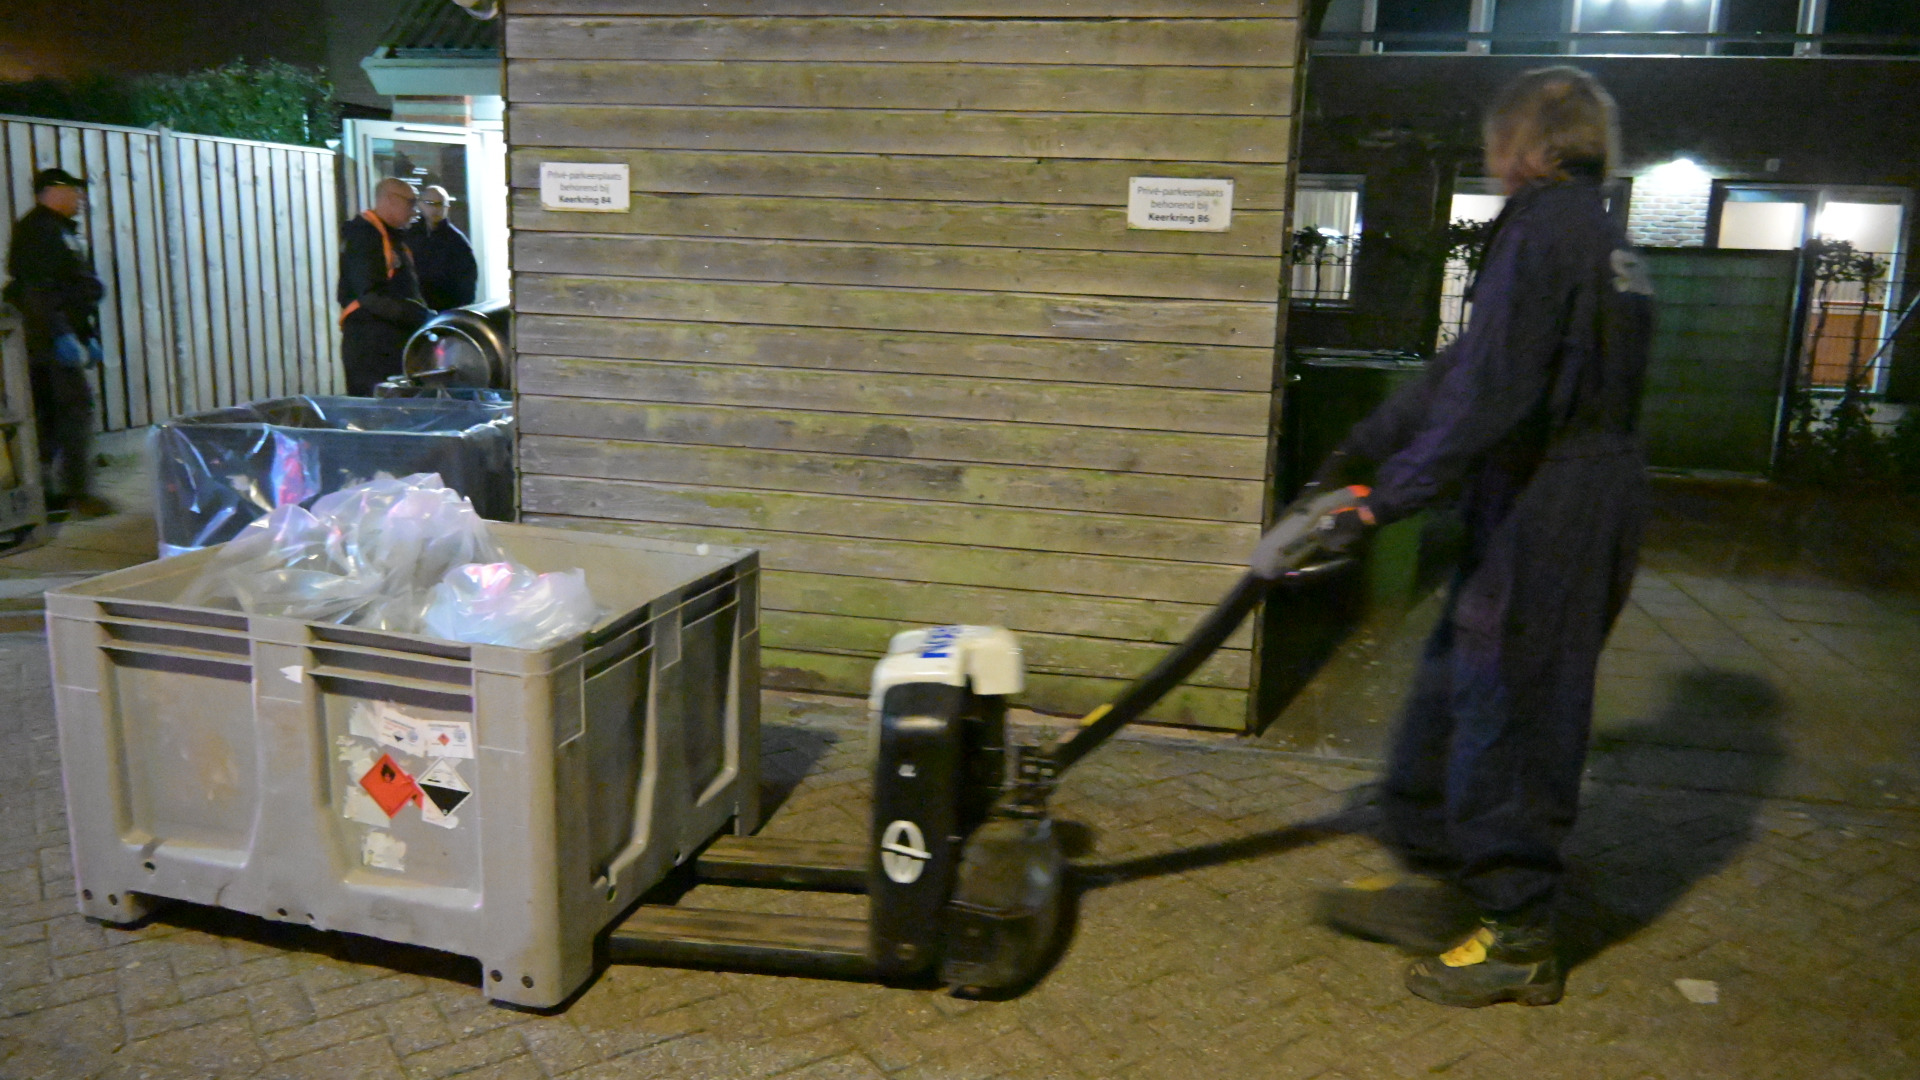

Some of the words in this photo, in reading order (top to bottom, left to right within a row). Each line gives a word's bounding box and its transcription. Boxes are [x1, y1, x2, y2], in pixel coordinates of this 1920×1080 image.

[560, 184, 598, 192] behorend
[559, 195, 599, 205] Keerkring
[601, 196, 611, 204] 84
[1150, 199, 1195, 209] behorend
[1197, 201, 1209, 212] bij
[1148, 213, 1195, 224] Keerkring
[1197, 214, 1210, 222] 86
